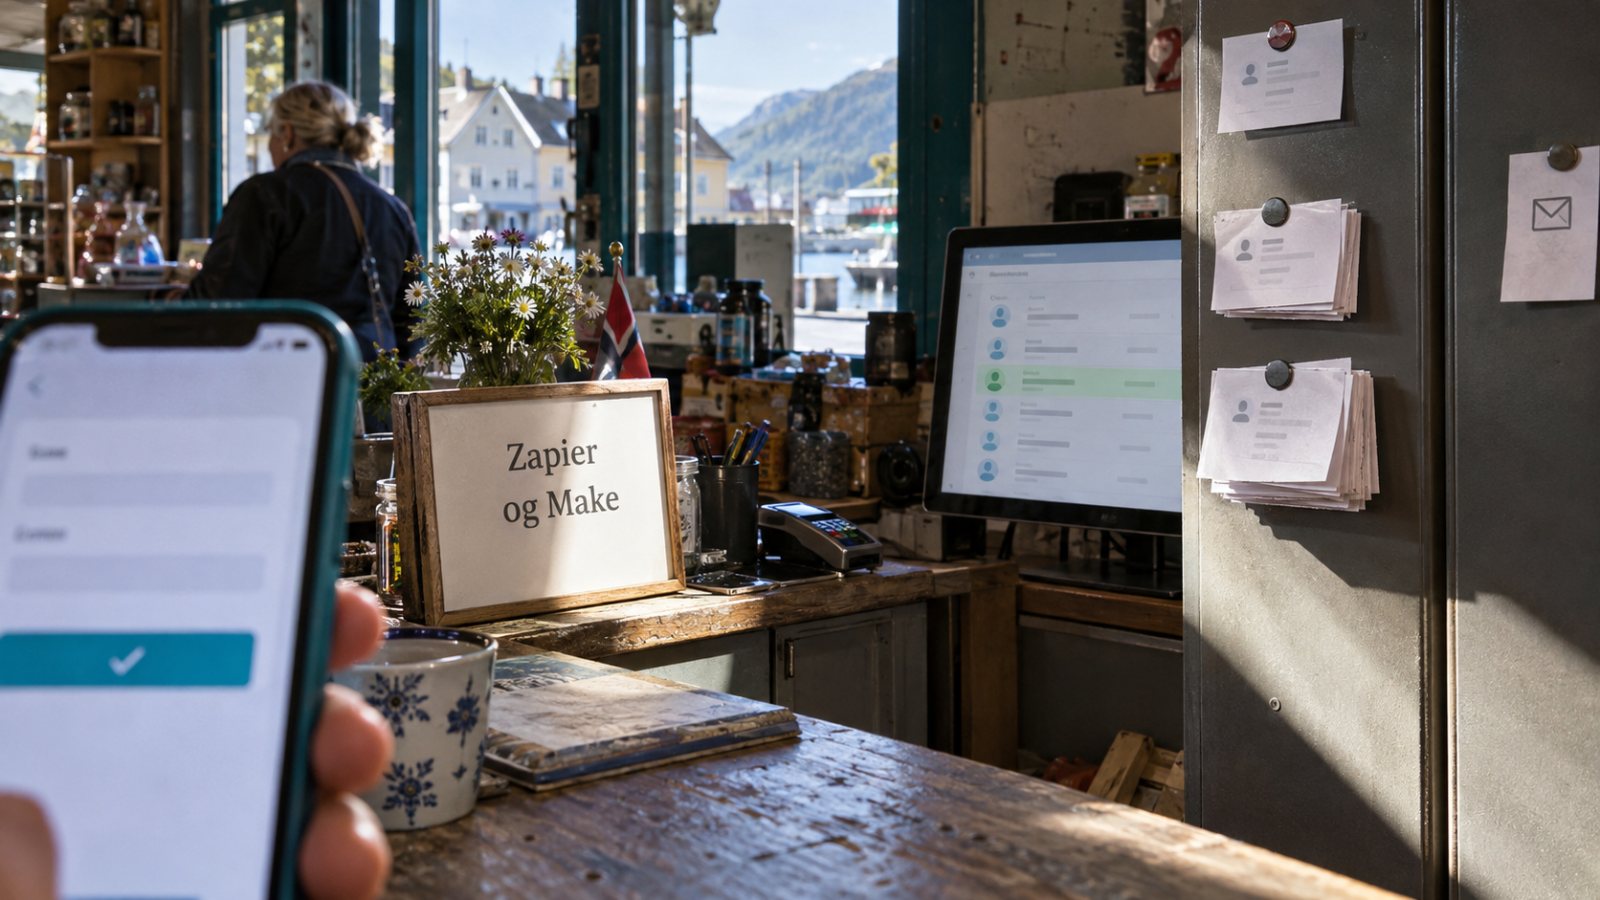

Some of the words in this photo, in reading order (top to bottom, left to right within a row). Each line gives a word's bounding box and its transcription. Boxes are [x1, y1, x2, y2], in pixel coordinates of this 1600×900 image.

[507, 438, 598, 476] Zapier
[503, 499, 540, 529] og
[546, 485, 619, 518] Make
